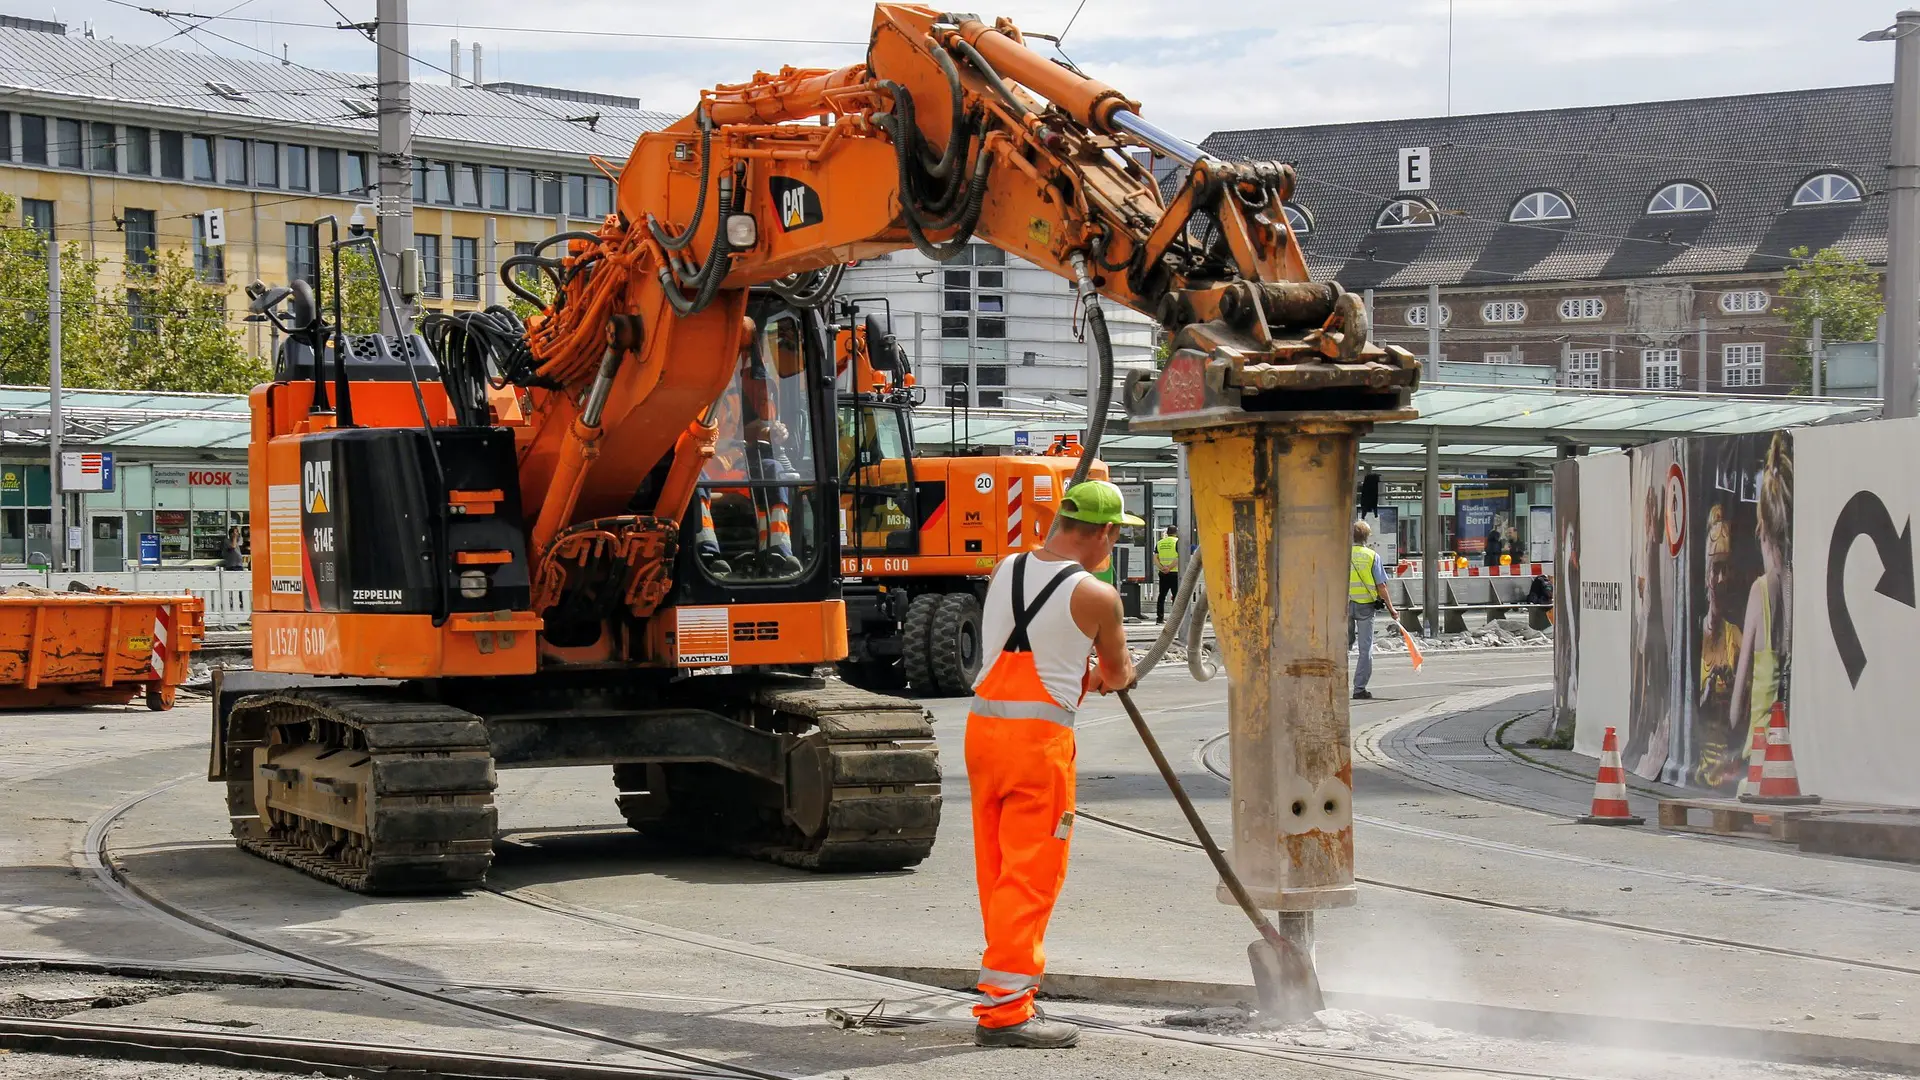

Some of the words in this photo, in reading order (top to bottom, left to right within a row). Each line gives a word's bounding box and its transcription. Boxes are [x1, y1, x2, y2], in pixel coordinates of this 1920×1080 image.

[1408, 155, 1421, 183] E
[783, 185, 805, 228] CAT
[210, 215, 219, 239] E
[103, 468, 110, 480] F
[188, 471, 232, 486] KIOSK
[977, 477, 992, 489] 20
[304, 460, 331, 514] CAT
[1466, 516, 1491, 525] Beruf
[313, 527, 334, 553] 314E
[884, 558, 909, 572] 600
[353, 590, 402, 600] ZEPPELIN
[269, 628, 298, 655] L1527
[304, 628, 325, 655] 600
